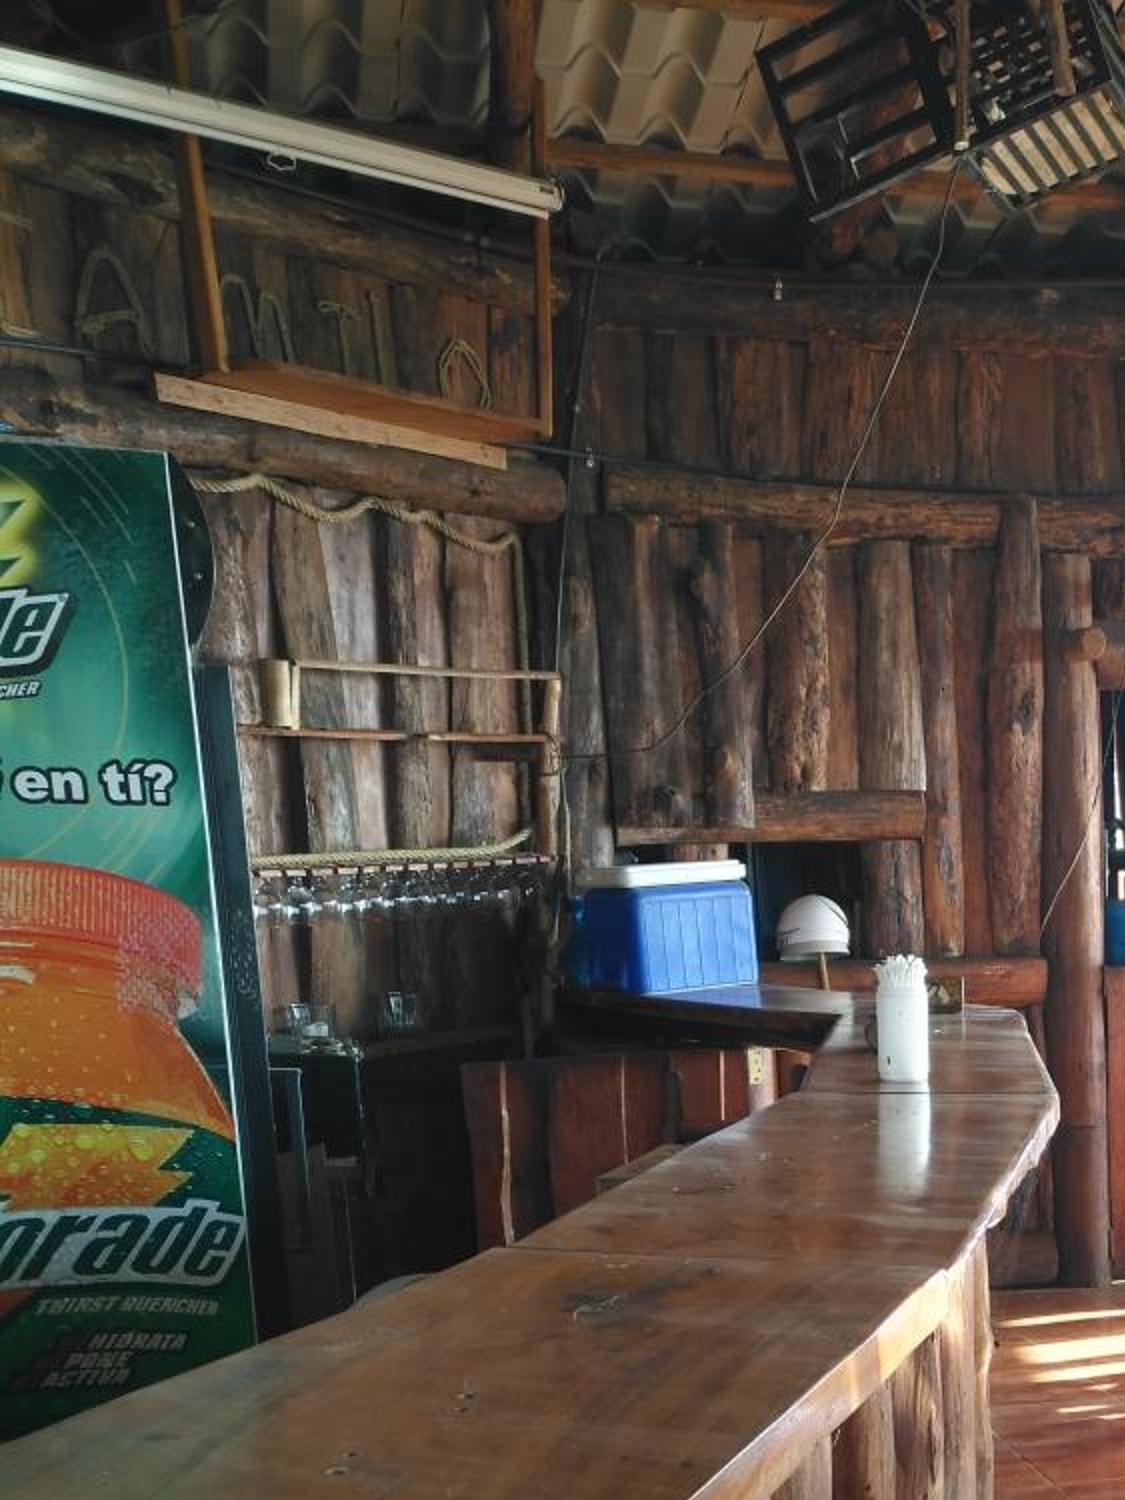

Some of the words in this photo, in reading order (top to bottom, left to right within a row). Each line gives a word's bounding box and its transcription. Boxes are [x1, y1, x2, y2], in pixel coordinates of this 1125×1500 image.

[0, 681, 40, 697] CHER
[14, 768, 85, 802] en
[102, 762, 174, 802] tí?
[0, 1199, 246, 1286] orade
[34, 1296, 120, 1315] THIRST
[121, 1296, 219, 1315] QUENCHER
